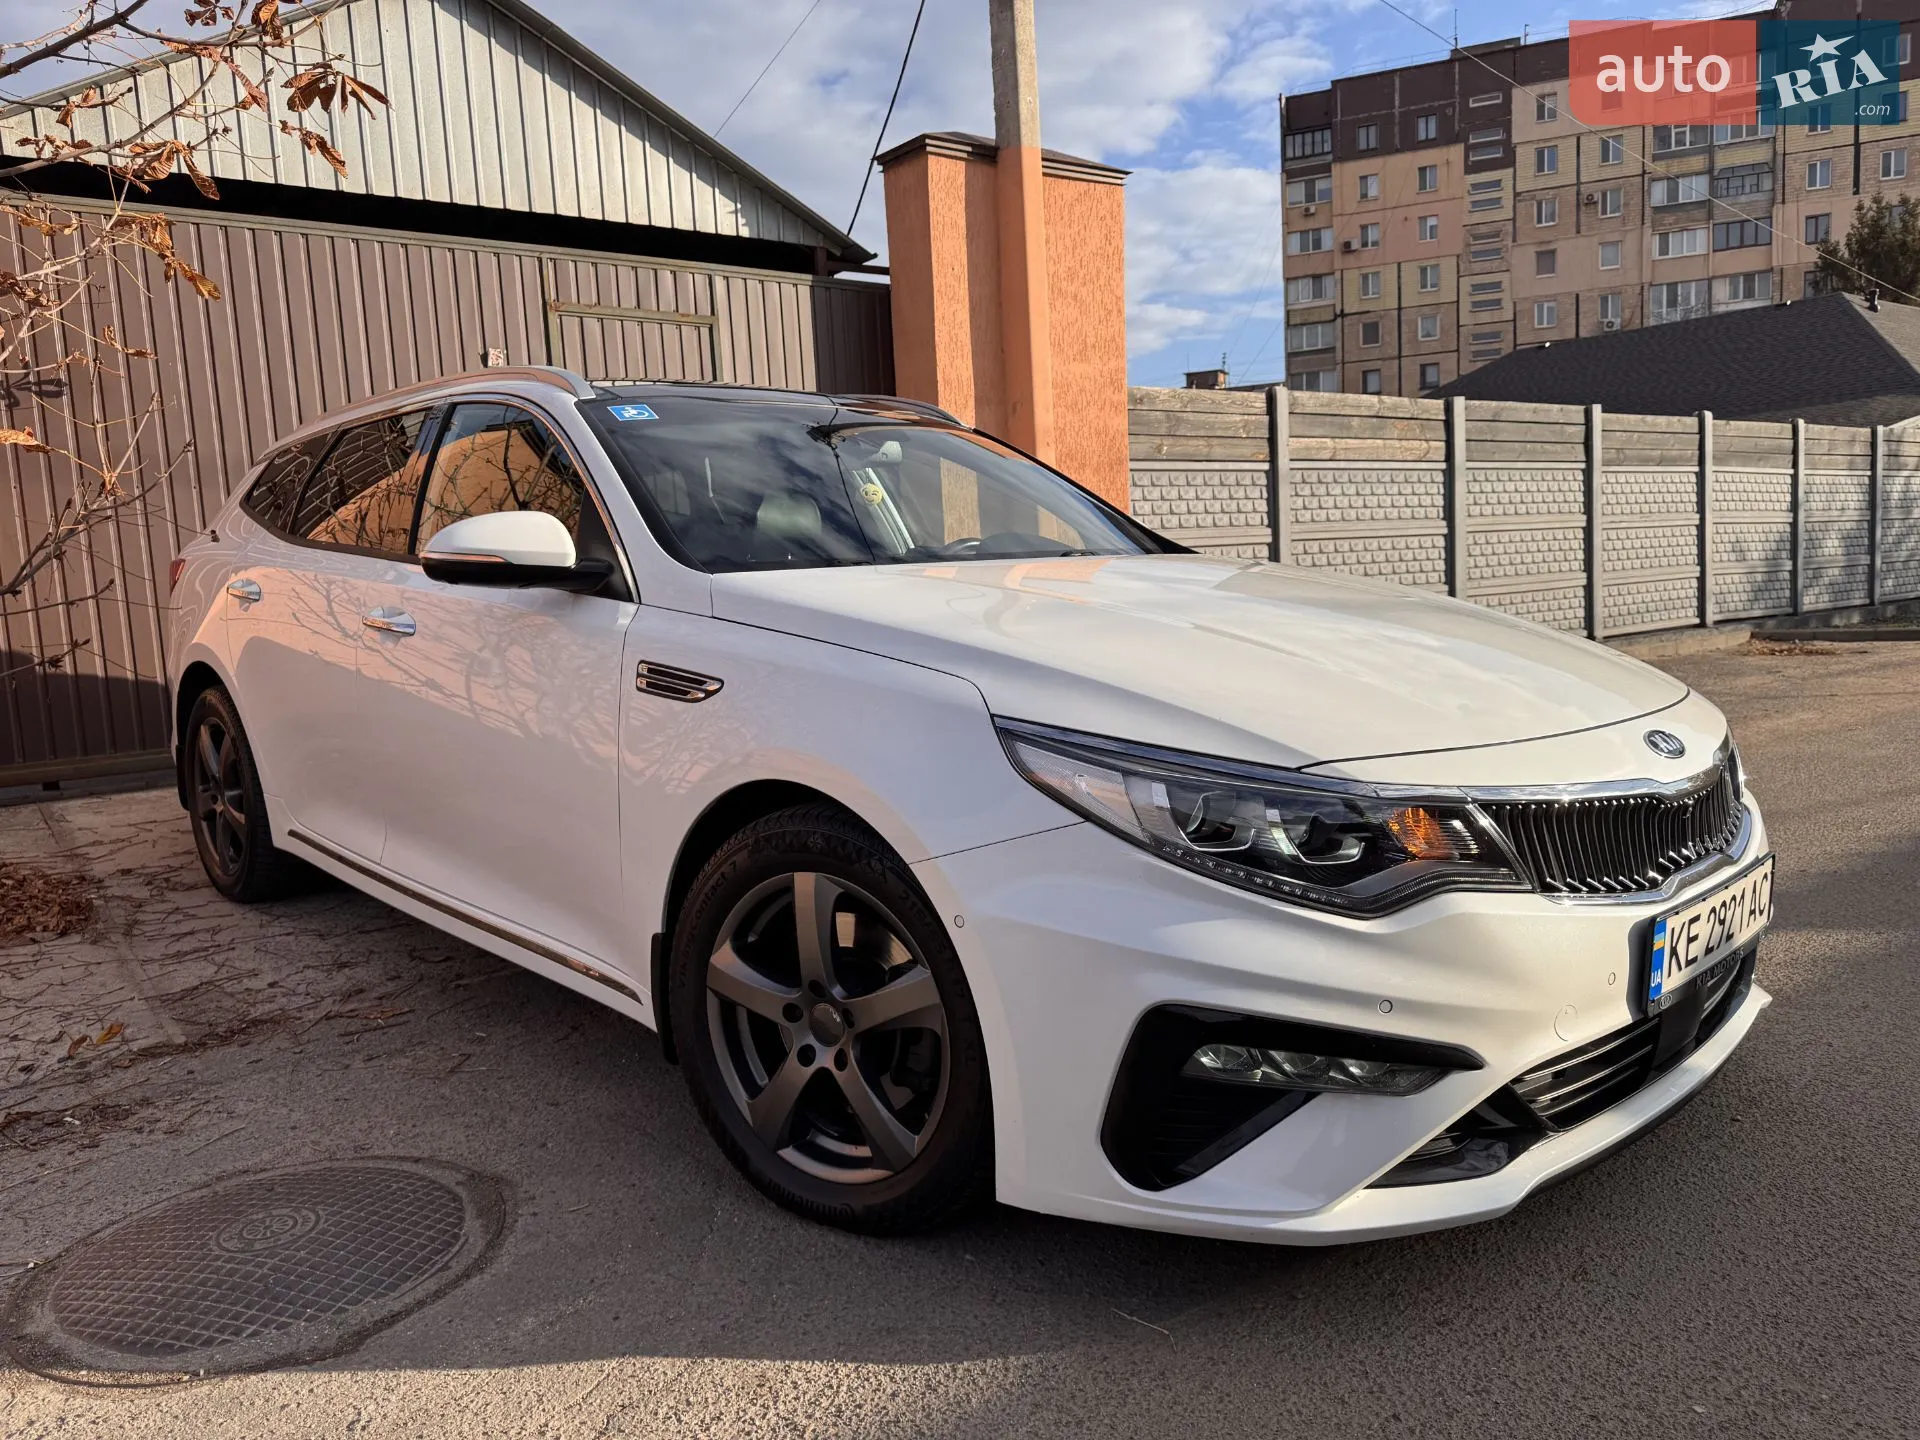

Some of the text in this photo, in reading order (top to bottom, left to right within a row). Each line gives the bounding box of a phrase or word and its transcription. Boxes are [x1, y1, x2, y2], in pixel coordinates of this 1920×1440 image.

[1667, 872, 1768, 978] KE 2921 AC
[1651, 969, 1661, 987] UA
[1696, 947, 1744, 989] KIA MOTORS
